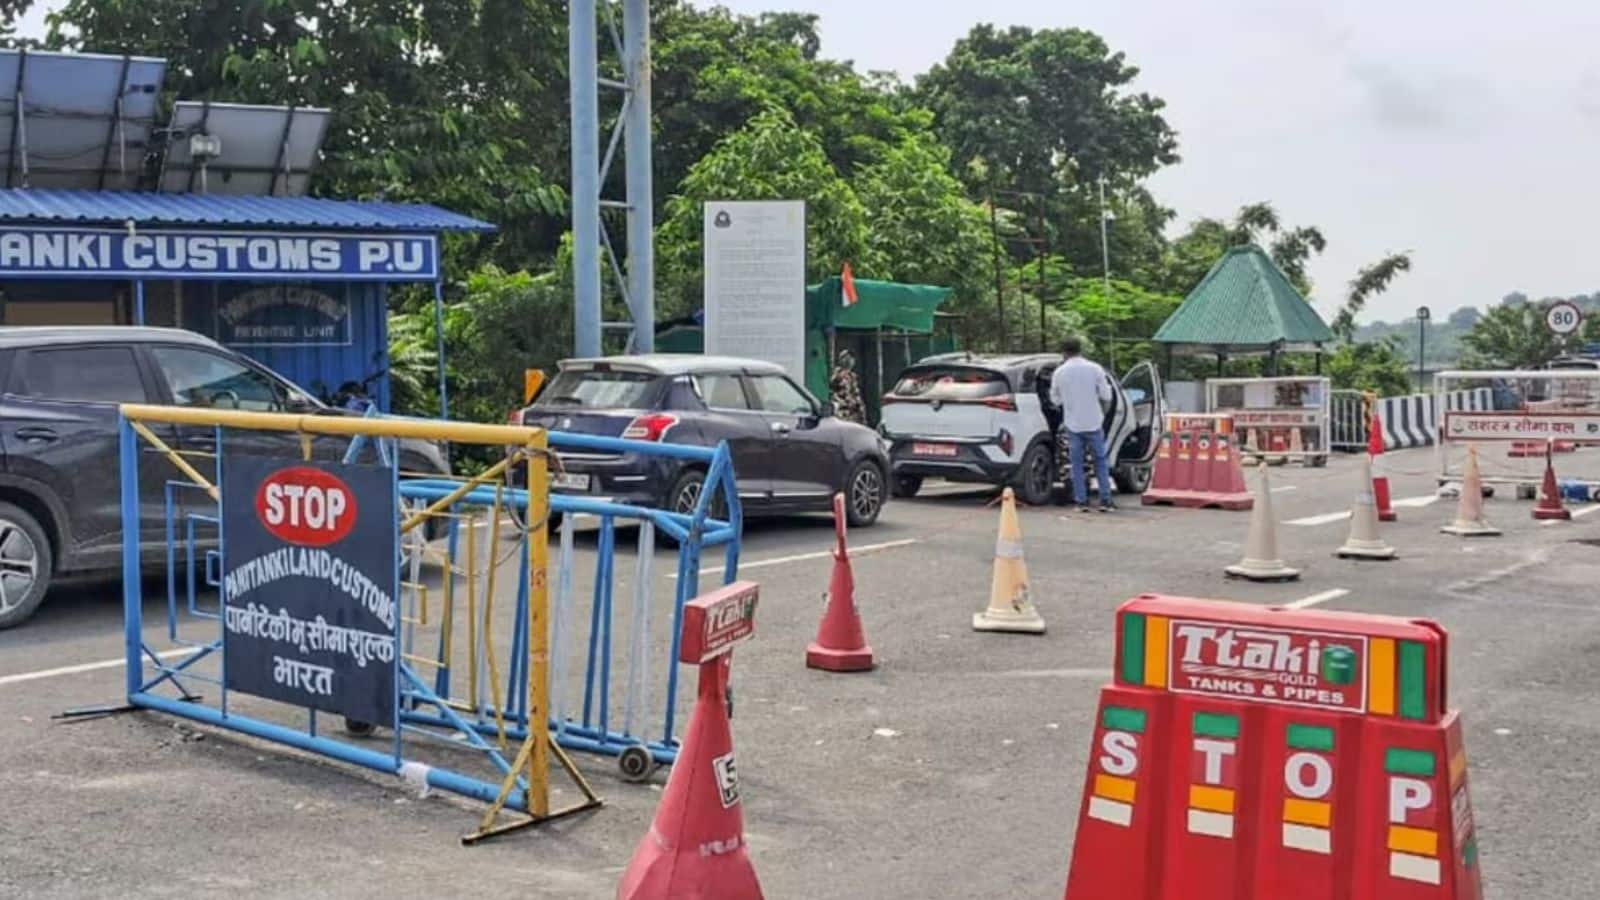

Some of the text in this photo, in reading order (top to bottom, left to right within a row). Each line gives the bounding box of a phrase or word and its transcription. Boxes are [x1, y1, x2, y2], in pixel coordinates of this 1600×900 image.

[123, 235, 341, 271] CUSTOMS
[359, 241, 423, 271] P.U
[1553, 311, 1573, 325] 80
[265, 483, 346, 530] STOP
[273, 655, 334, 695] भारत
[1187, 676, 1344, 704] TANKS & PIPES
[1278, 672, 1317, 686] GOLD
